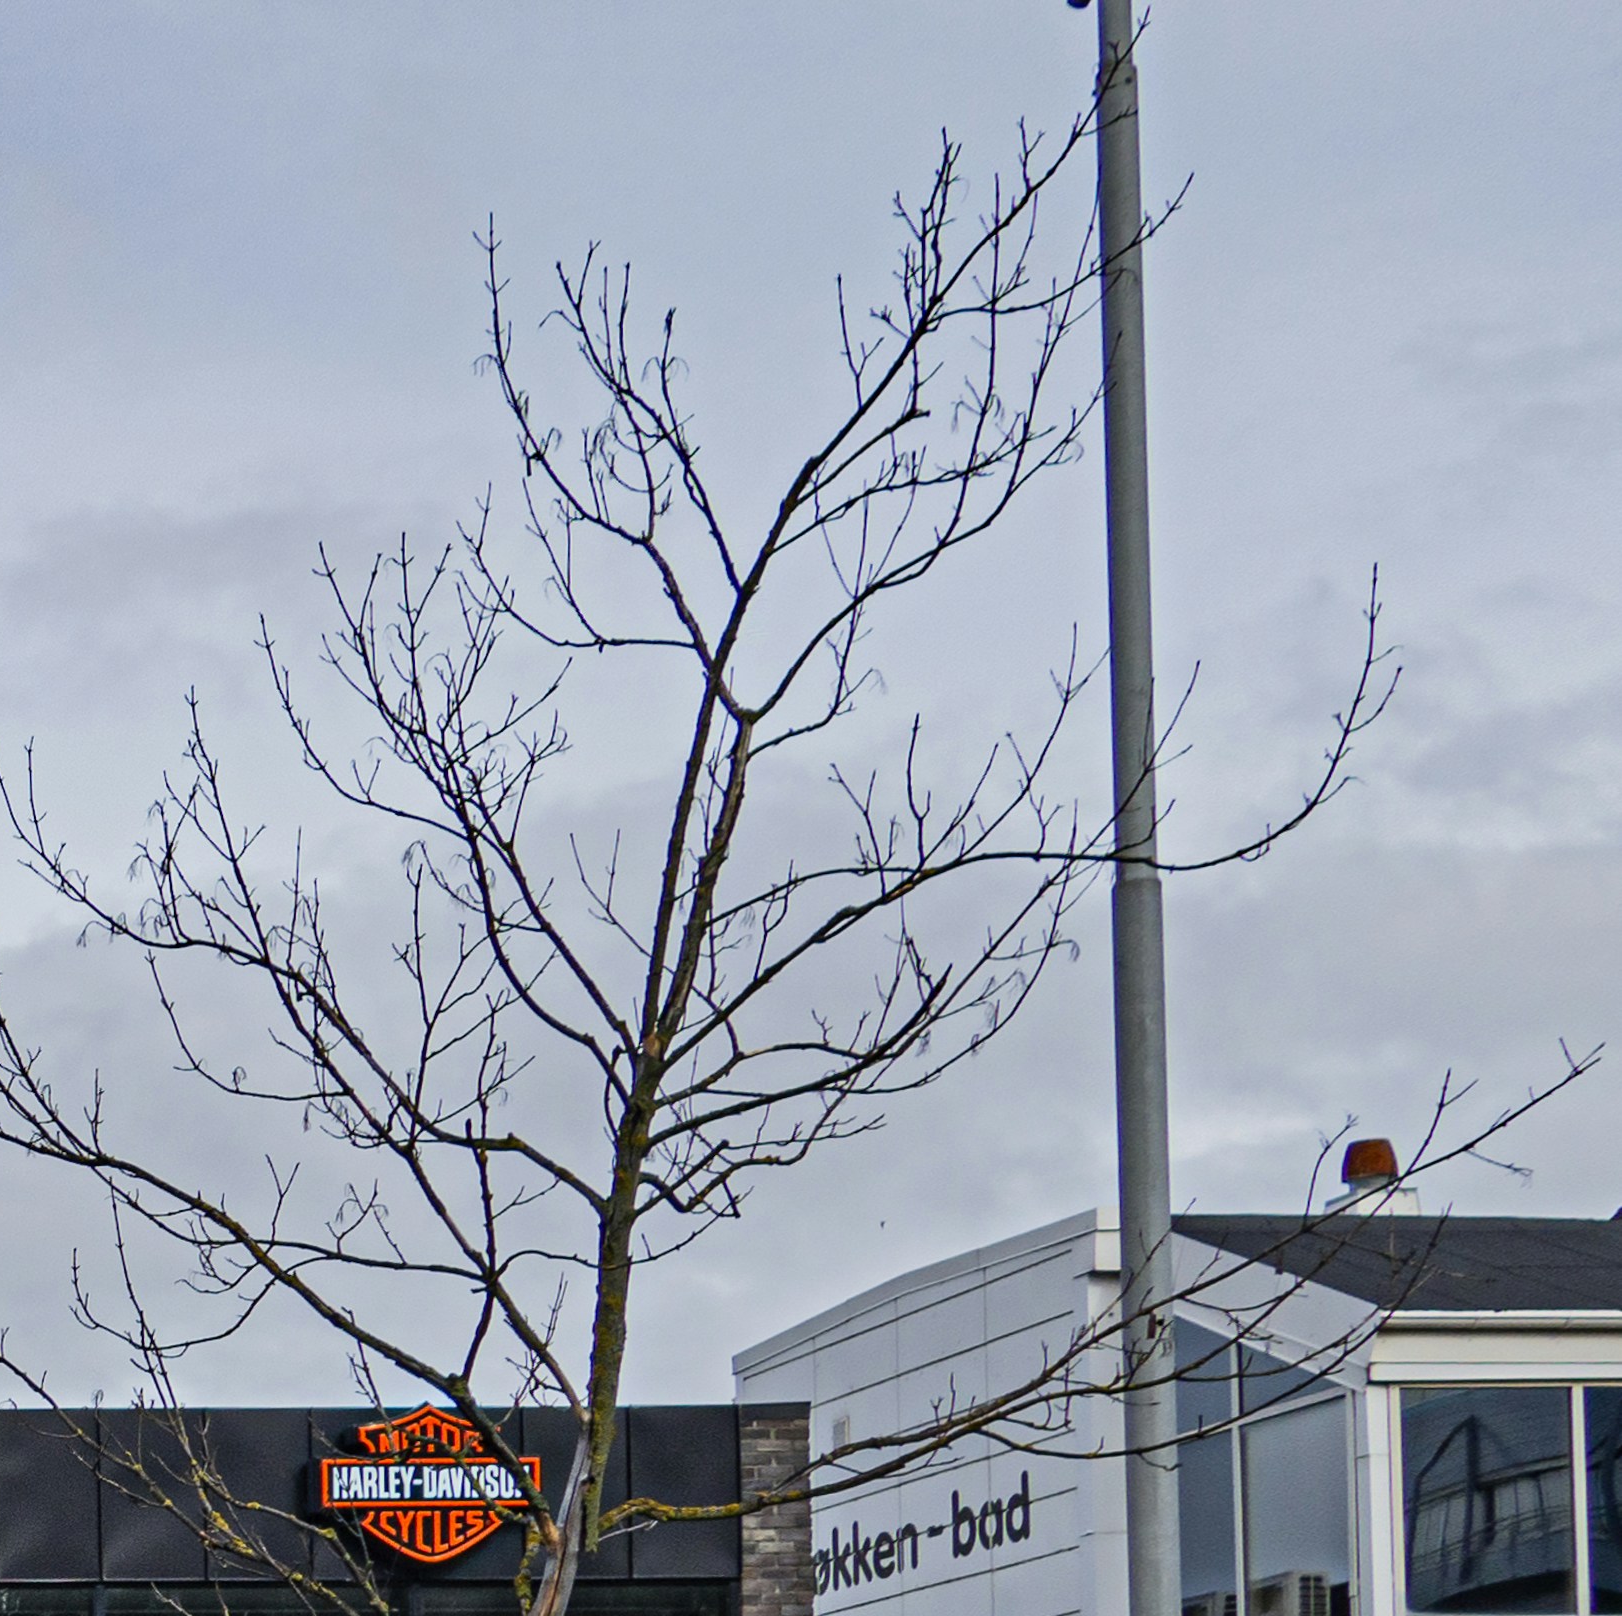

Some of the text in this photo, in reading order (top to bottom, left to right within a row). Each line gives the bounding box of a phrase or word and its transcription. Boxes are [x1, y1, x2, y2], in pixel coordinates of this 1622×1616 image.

[332, 1464, 530, 1500] HARLEY-DAVIDSO
[379, 1510, 484, 1554] CYCLES
[951, 1470, 1031, 1559] bad
